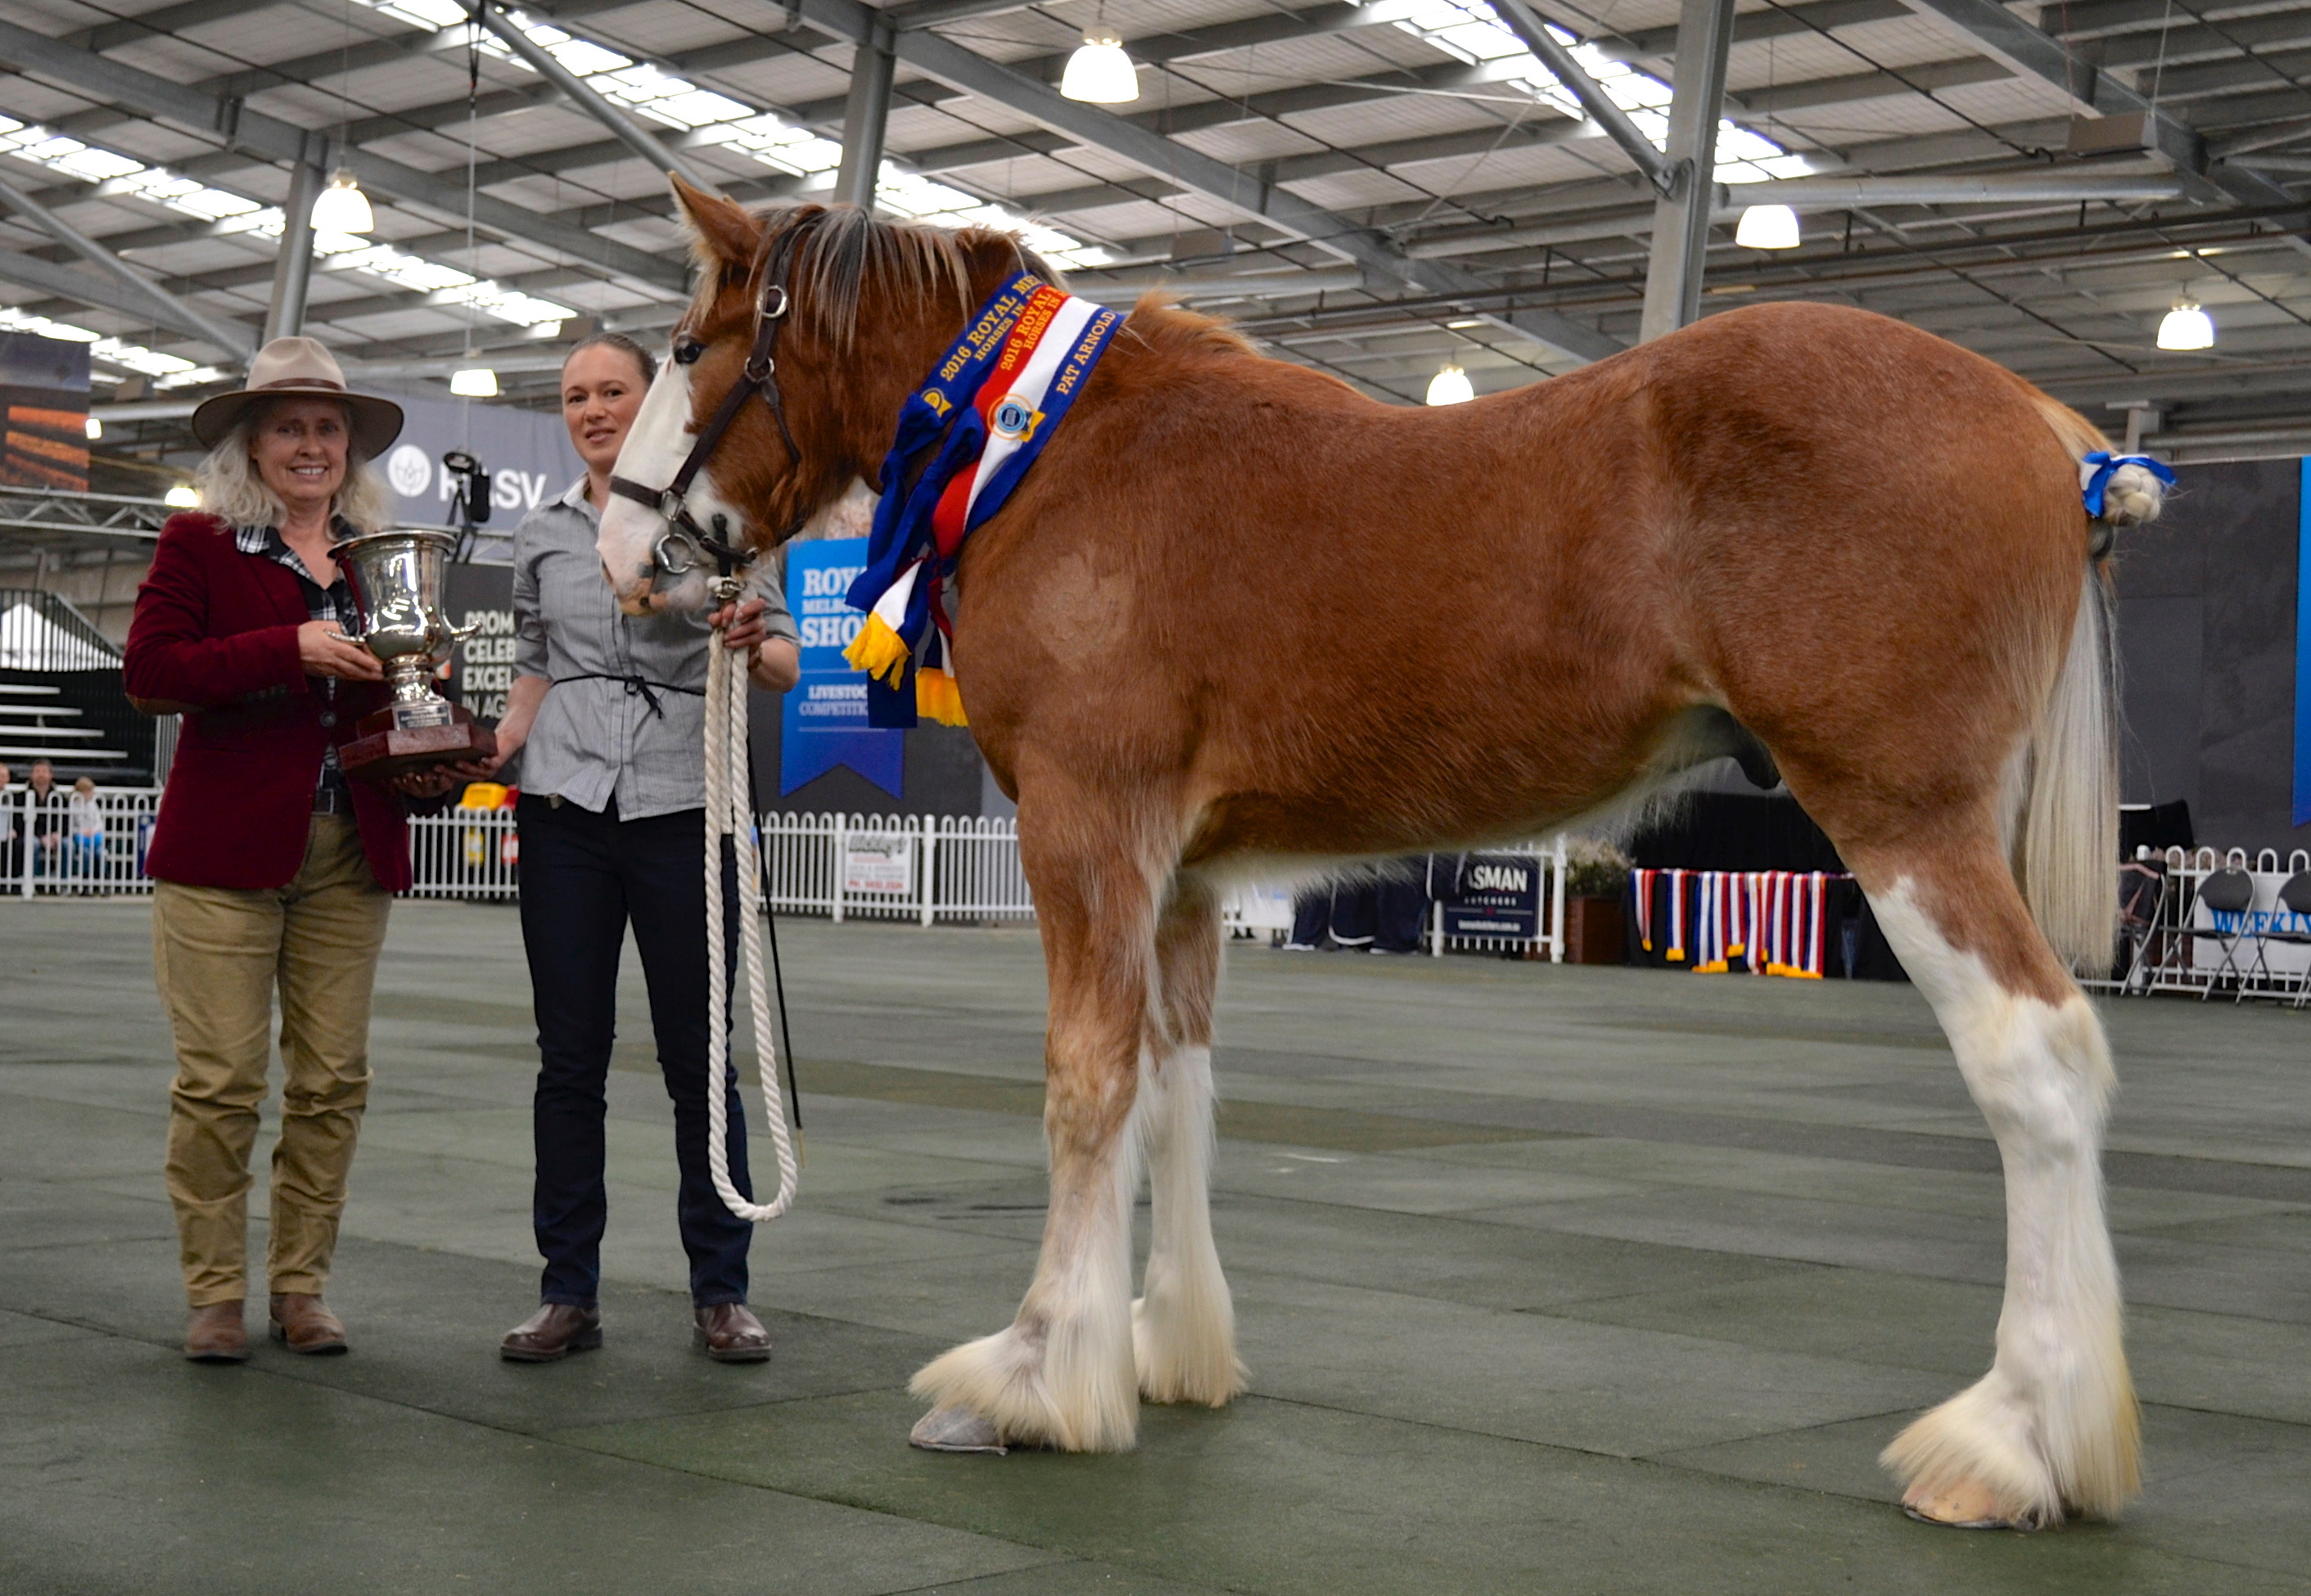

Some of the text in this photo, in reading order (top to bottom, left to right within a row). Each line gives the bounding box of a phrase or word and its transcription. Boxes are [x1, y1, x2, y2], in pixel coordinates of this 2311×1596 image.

[941, 345, 972, 381] 2016
[967, 294, 1017, 346] ROYAL
[974, 302, 1026, 363] HORSES IN
[1000, 337, 1023, 371] 2016
[1015, 292, 1052, 336] ROYAL
[1023, 309, 1053, 351] HORSES
[1047, 296, 1062, 309] IN
[1056, 311, 1116, 395] PAT ARNOLD
[802, 566, 868, 597] ROY
[801, 614, 867, 648] SHO
